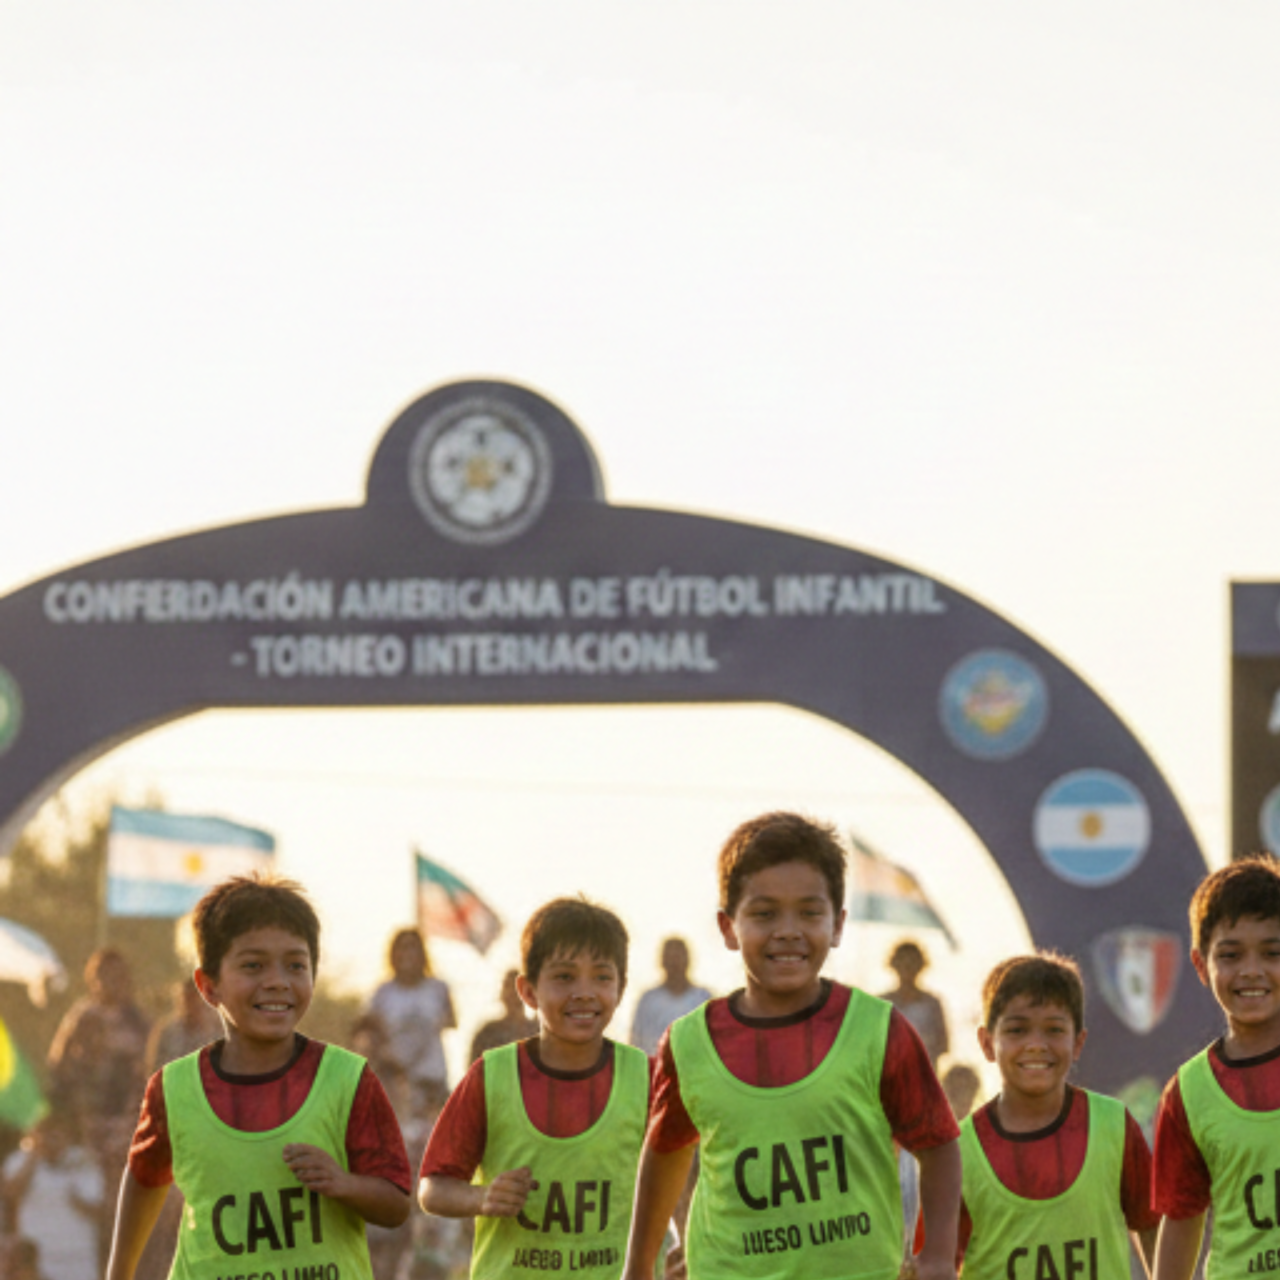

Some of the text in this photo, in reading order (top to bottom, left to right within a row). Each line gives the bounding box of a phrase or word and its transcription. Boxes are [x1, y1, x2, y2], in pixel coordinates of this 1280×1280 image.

[338, 577, 563, 621] AMERICANA
[570, 577, 619, 618] DE
[627, 568, 768, 617] FÚTBOL
[774, 573, 945, 615] INFANTIL
[251, 634, 405, 677] TORNEO
[413, 631, 718, 675] INTERNACIONAL
[735, 1134, 849, 1211] CAFI
[211, 1186, 323, 1256] CAFI
